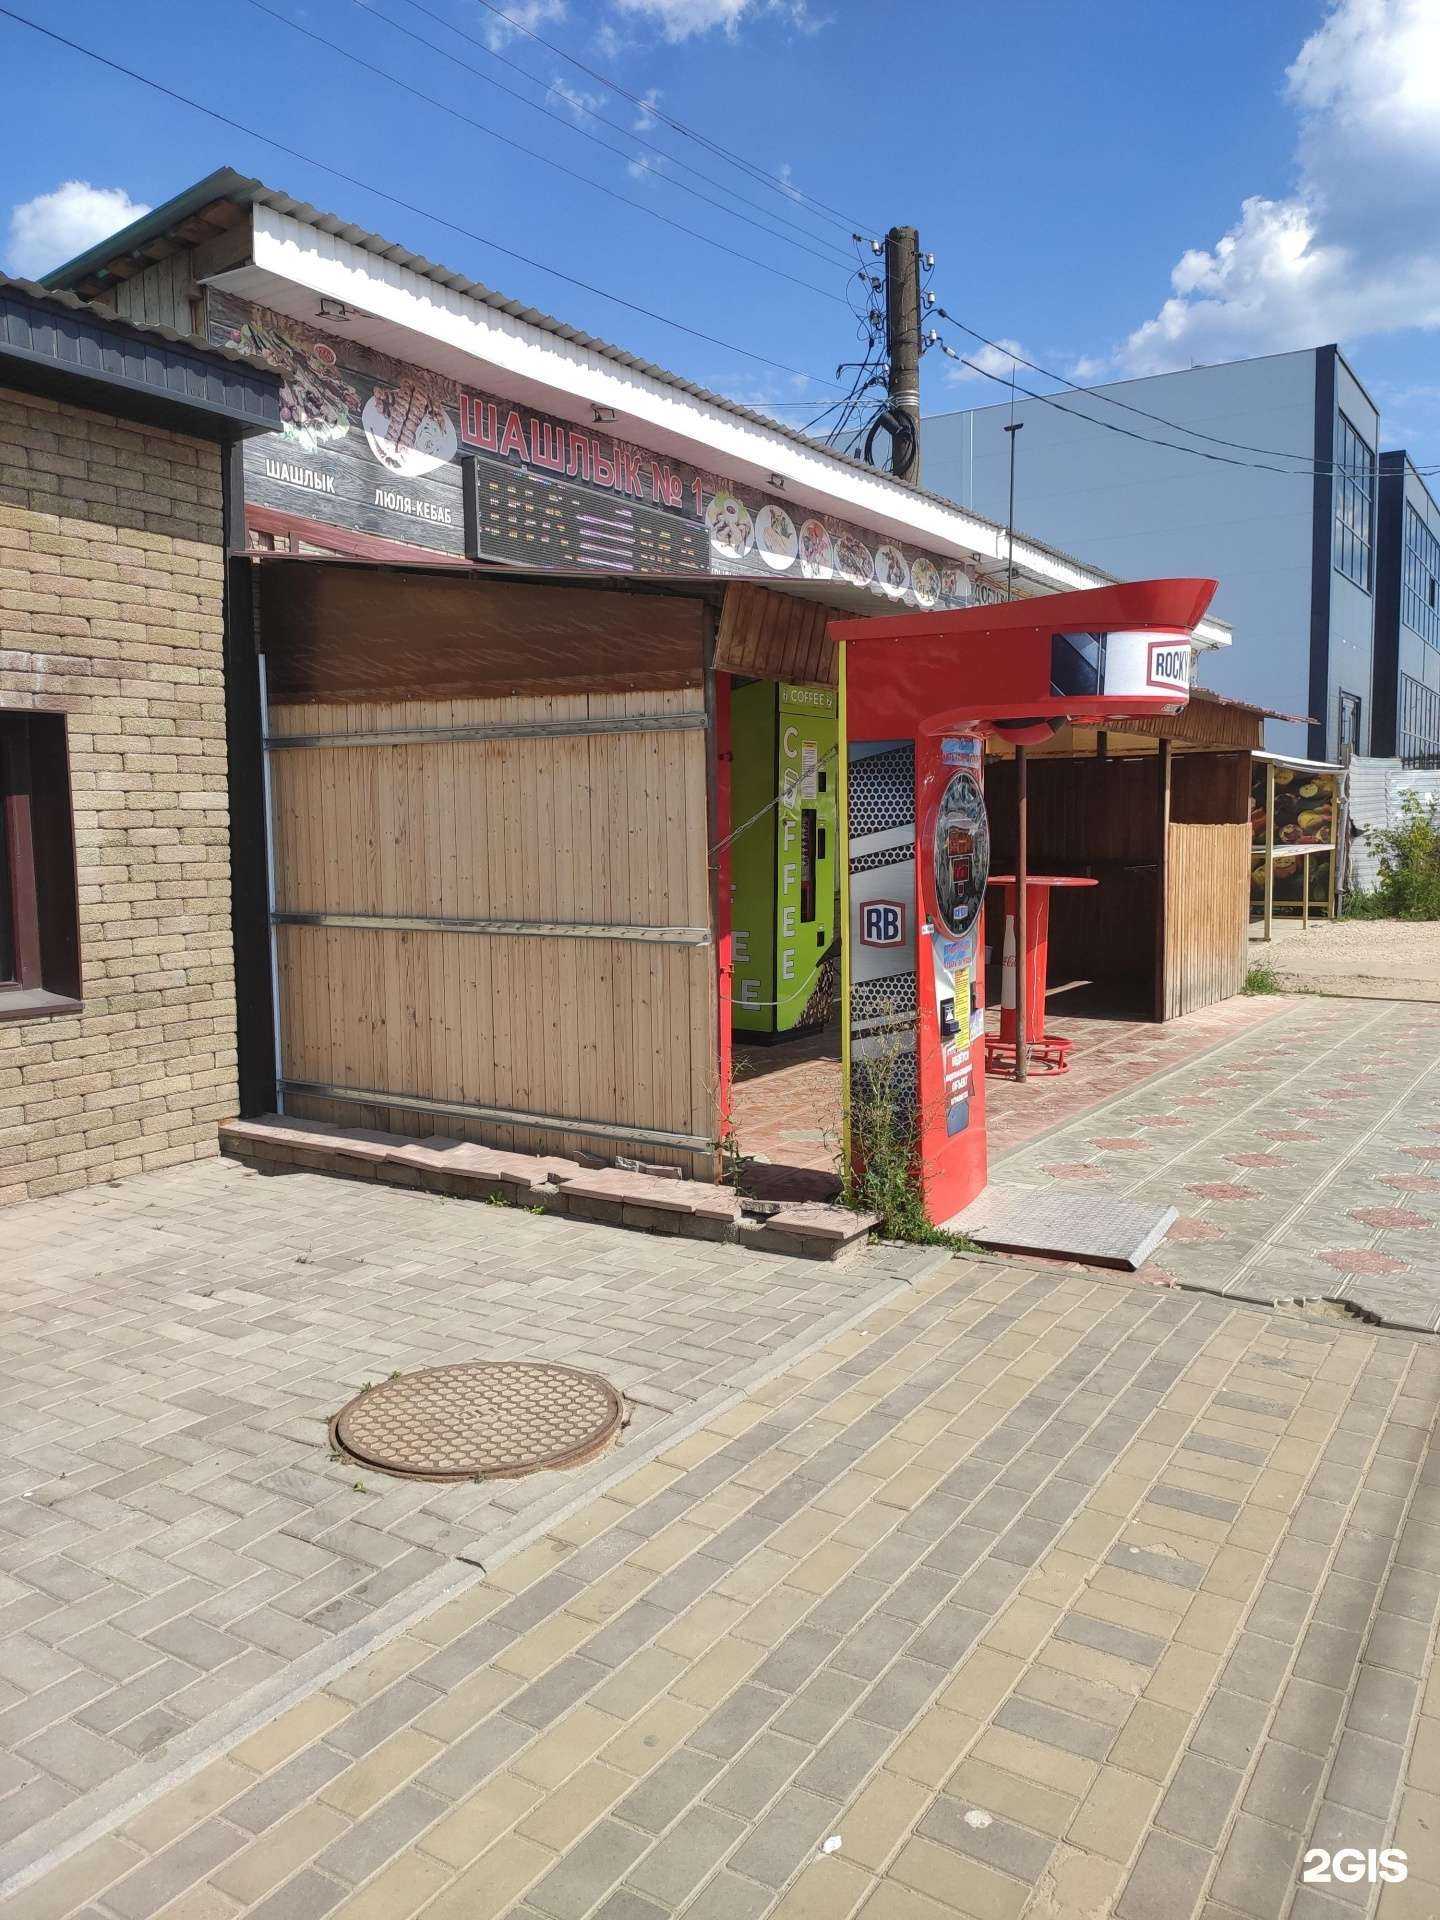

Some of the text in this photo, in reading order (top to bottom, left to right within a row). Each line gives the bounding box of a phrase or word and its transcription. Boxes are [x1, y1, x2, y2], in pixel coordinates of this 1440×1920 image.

[458, 393, 645, 499] ШАШЛЫК
[691, 476, 704, 517] 1
[265, 458, 336, 495] ШАШЛЫК
[374, 489, 453, 525] ЛЮЛЯ-КЕБАБ
[1155, 650, 1190, 683] ROCKY
[791, 690, 825, 706] COFFEE
[866, 907, 899, 941] RB
